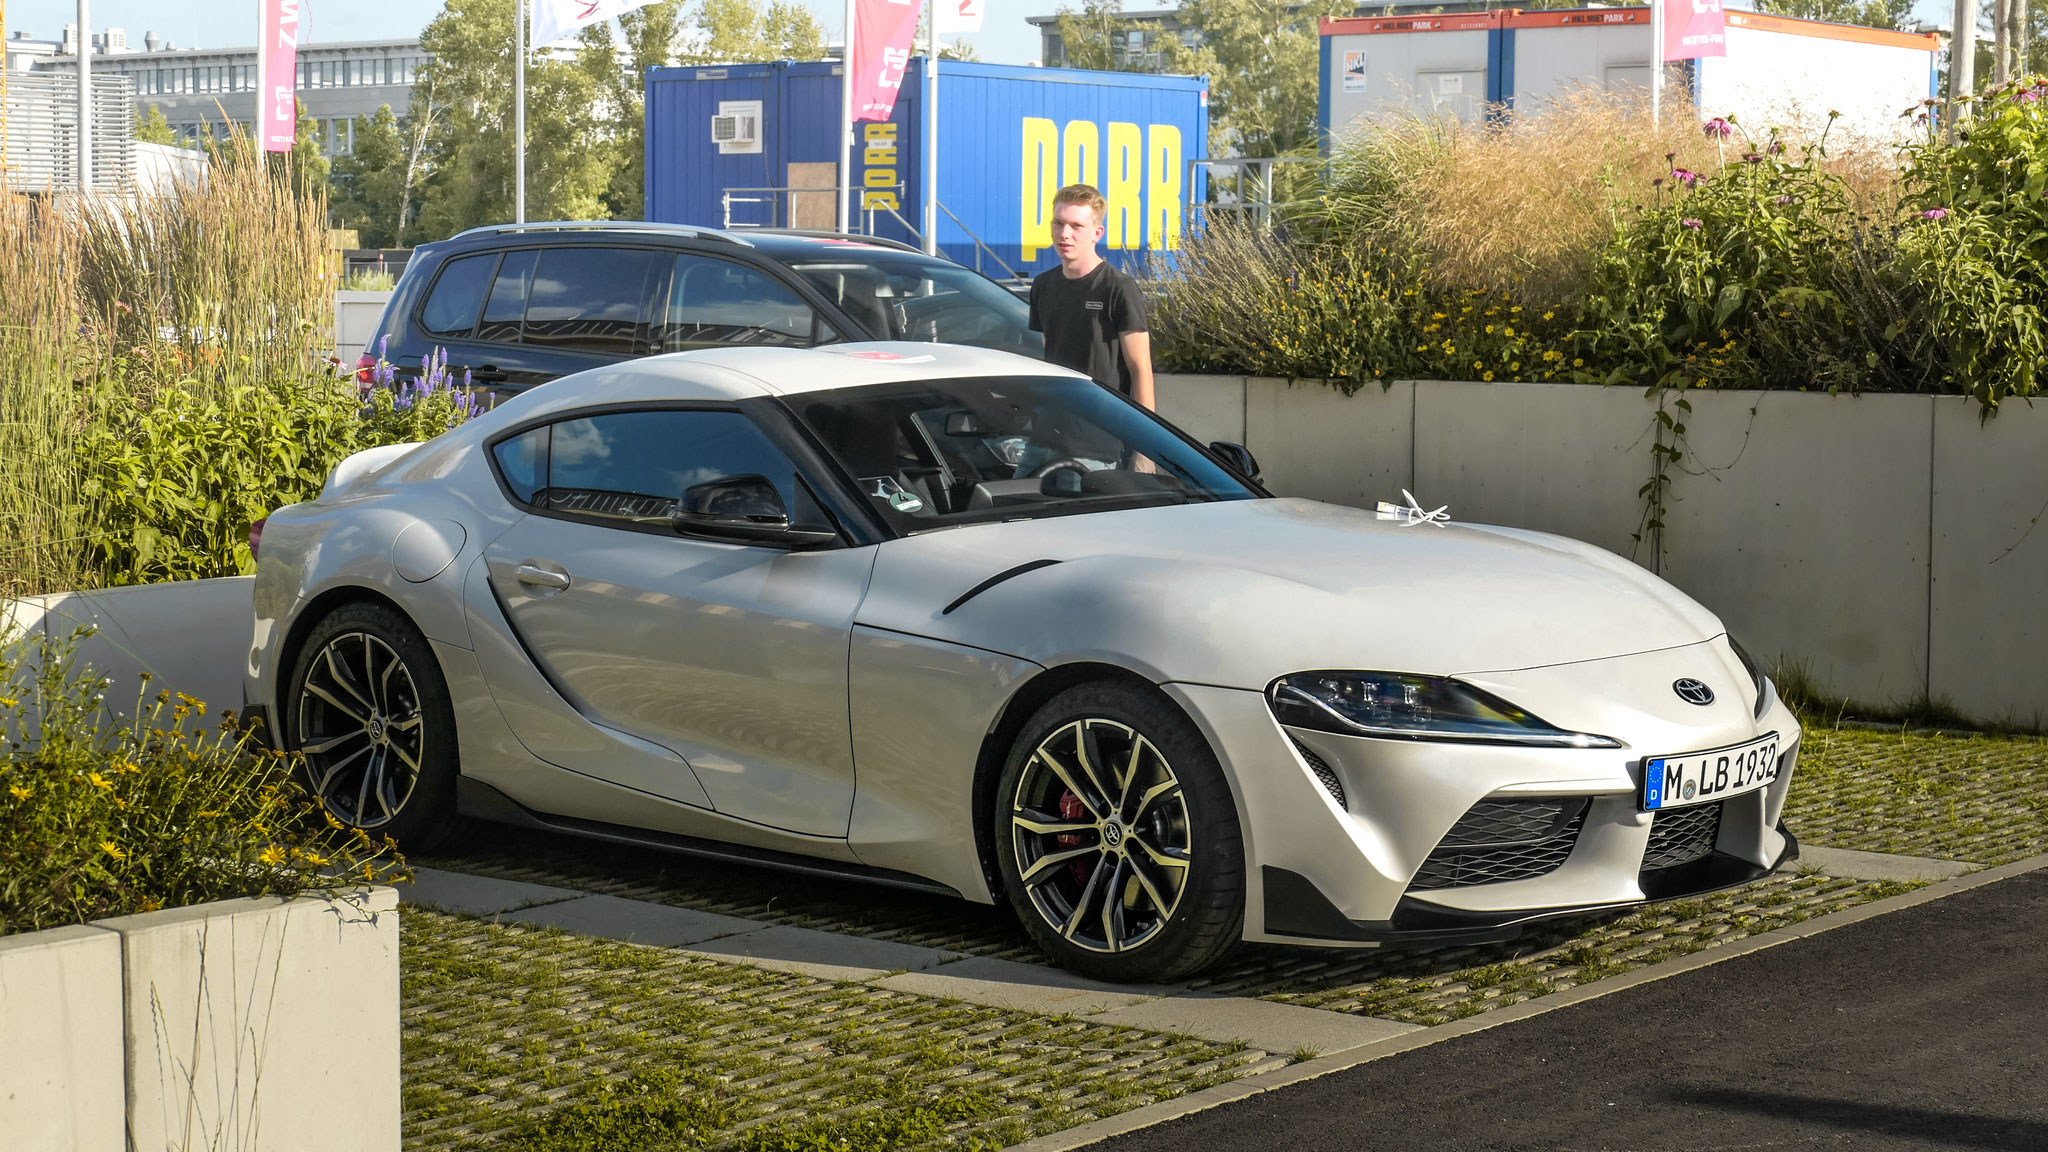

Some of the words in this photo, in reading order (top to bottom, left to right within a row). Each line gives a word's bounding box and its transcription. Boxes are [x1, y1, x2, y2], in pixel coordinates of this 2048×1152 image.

[864, 122, 899, 210] PORR
[1021, 117, 1181, 262] PORR
[1650, 789, 1658, 800] D
[1664, 763, 1683, 801] M
[1699, 756, 1730, 796] LB
[1733, 743, 1777, 789] 1932
